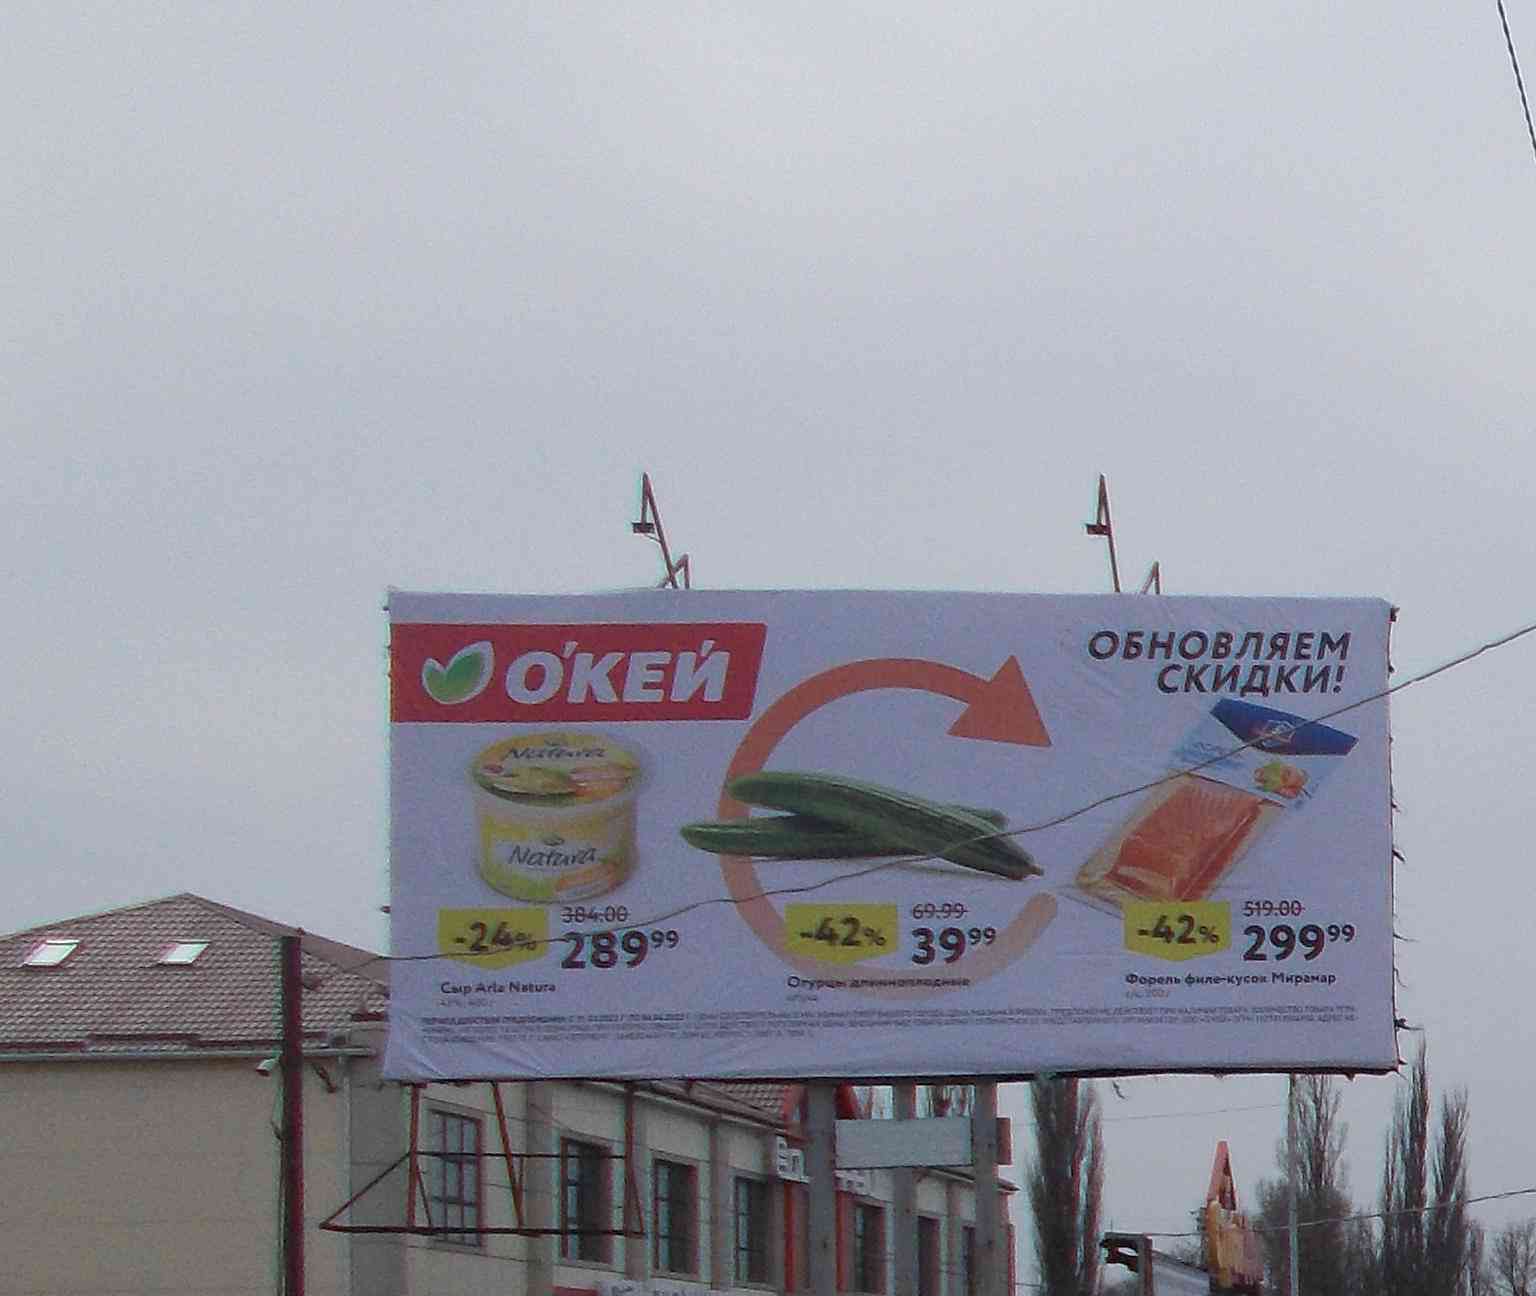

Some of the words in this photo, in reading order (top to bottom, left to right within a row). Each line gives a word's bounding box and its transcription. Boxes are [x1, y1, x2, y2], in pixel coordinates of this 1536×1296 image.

[1088, 630, 1352, 661] ОБНОВЛЯЕМ
[1157, 662, 1346, 696] СКИДКИ!
[508, 845, 597, 866] Natura
[800, 916, 887, 946] -42%
[1137, 914, 1221, 946] -42%
[440, 981, 474, 995] Сыр
[1125, 973, 1181, 985] Форель
[1184, 972, 1267, 987] филе-кусок
[1271, 971, 1337, 986] Мирамар
